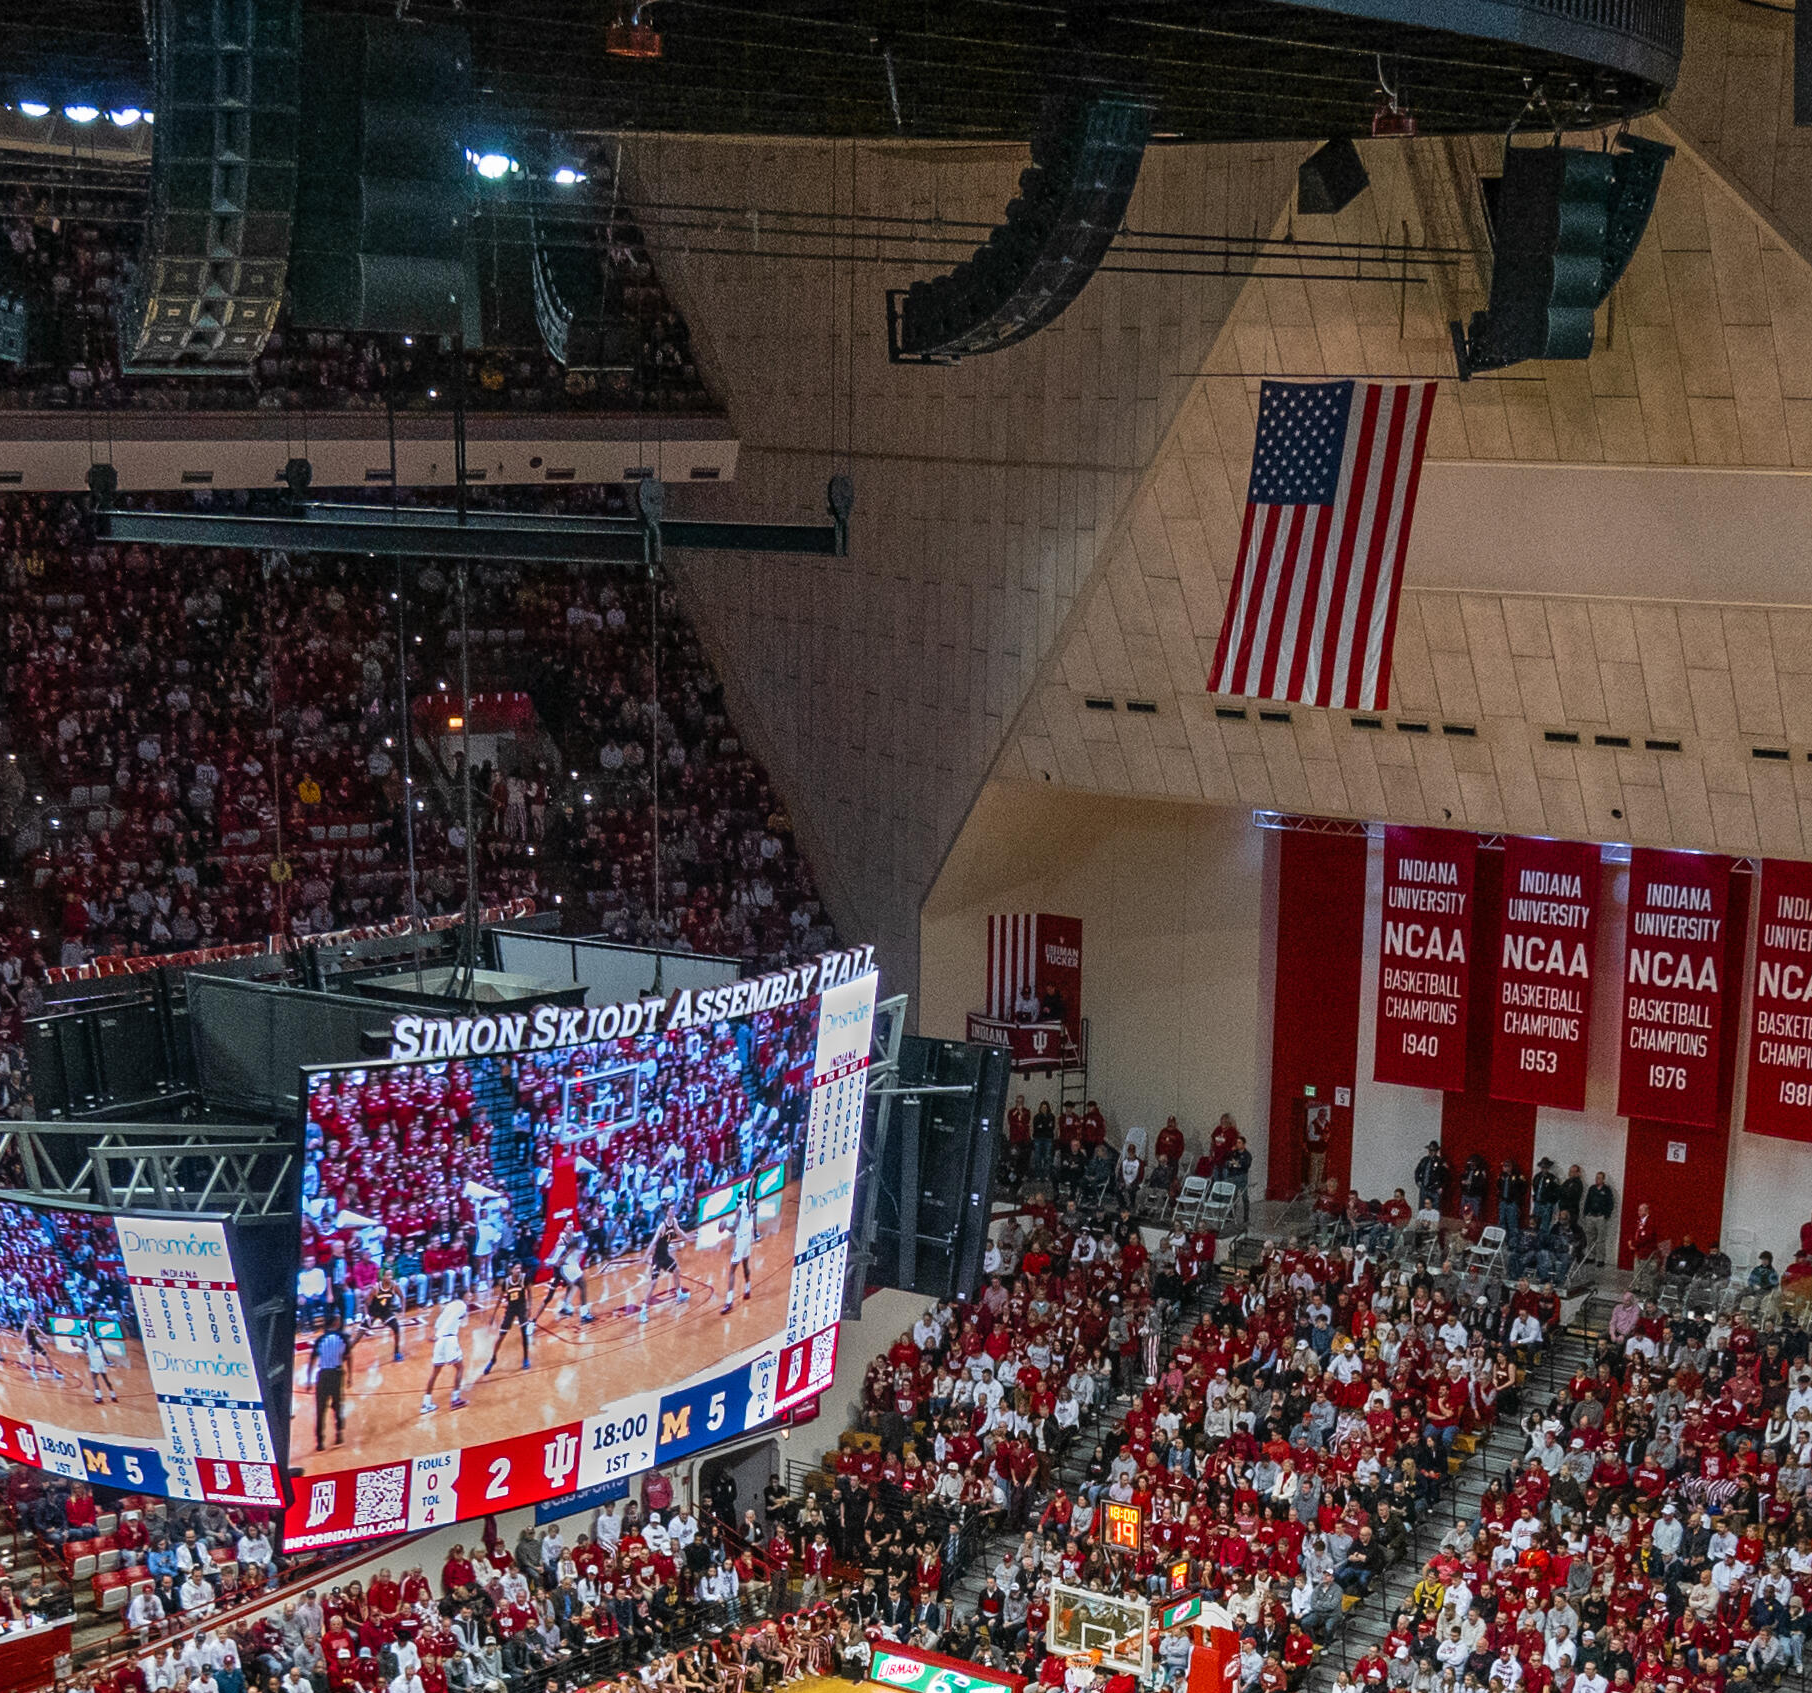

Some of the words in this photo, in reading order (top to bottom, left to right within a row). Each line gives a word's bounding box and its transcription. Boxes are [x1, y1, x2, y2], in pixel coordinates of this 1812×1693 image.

[1399, 859, 1458, 885] INDIANA
[1520, 870, 1581, 898] INDIANA
[1389, 886, 1466, 915] UNIVERSITY
[1646, 883, 1711, 911] INDIANA
[1509, 899, 1589, 929] UNIVERSITY
[1635, 912, 1721, 942] UNIVERSITY
[1385, 921, 1465, 963] NCAA
[1503, 934, 1588, 978] NCAA
[1384, 968, 1461, 998] BASKETBALL
[1629, 949, 1717, 992] NCAA
[391, 1013, 527, 1060] SIMON
[529, 995, 666, 1049] SKJODT
[667, 962, 817, 1030] ASSEMBLY
[816, 944, 876, 994] HALL
[1503, 982, 1583, 1013] BASKETBALL
[1386, 997, 1457, 1025] CHAMPIONS
[1628, 997, 1712, 1028] BASKETBALL
[971, 1023, 1009, 1045] INDIANA
[1504, 1012, 1579, 1041] CHAMPIONS
[1402, 1033, 1438, 1057] 1940
[1630, 1027, 1707, 1057] CHAMPIONS
[1520, 1048, 1557, 1073] 1953
[1649, 1064, 1686, 1089] 1976
[1780, 1081, 1812, 1107] 1981
[160, 1269, 198, 1279] INDIANA
[757, 1356, 777, 1372] FOULS
[762, 1373, 768, 1388] 0
[660, 1406, 691, 1445] M
[707, 1391, 725, 1431] 5
[758, 1404, 765, 1418] 4
[593, 1413, 648, 1450] 18:00
[40, 1435, 77, 1459] 18:00
[55, 1462, 71, 1474] 1ST
[83, 1449, 112, 1476] M
[124, 1456, 144, 1484] 5
[417, 1455, 451, 1472] FOULS
[485, 1457, 511, 1500] 2
[544, 1432, 578, 1489] IU
[606, 1453, 630, 1474] 1ST
[427, 1474, 438, 1491] 0
[315, 1498, 330, 1514] IN
[422, 1495, 440, 1508] TOL
[1109, 1505, 1138, 1523] 18:00
[424, 1508, 435, 1525] 4
[284, 1518, 406, 1550] INFORINDIANA.COM
[1117, 1522, 1135, 1546] 19
[878, 1662, 920, 1679] LIBMAN
